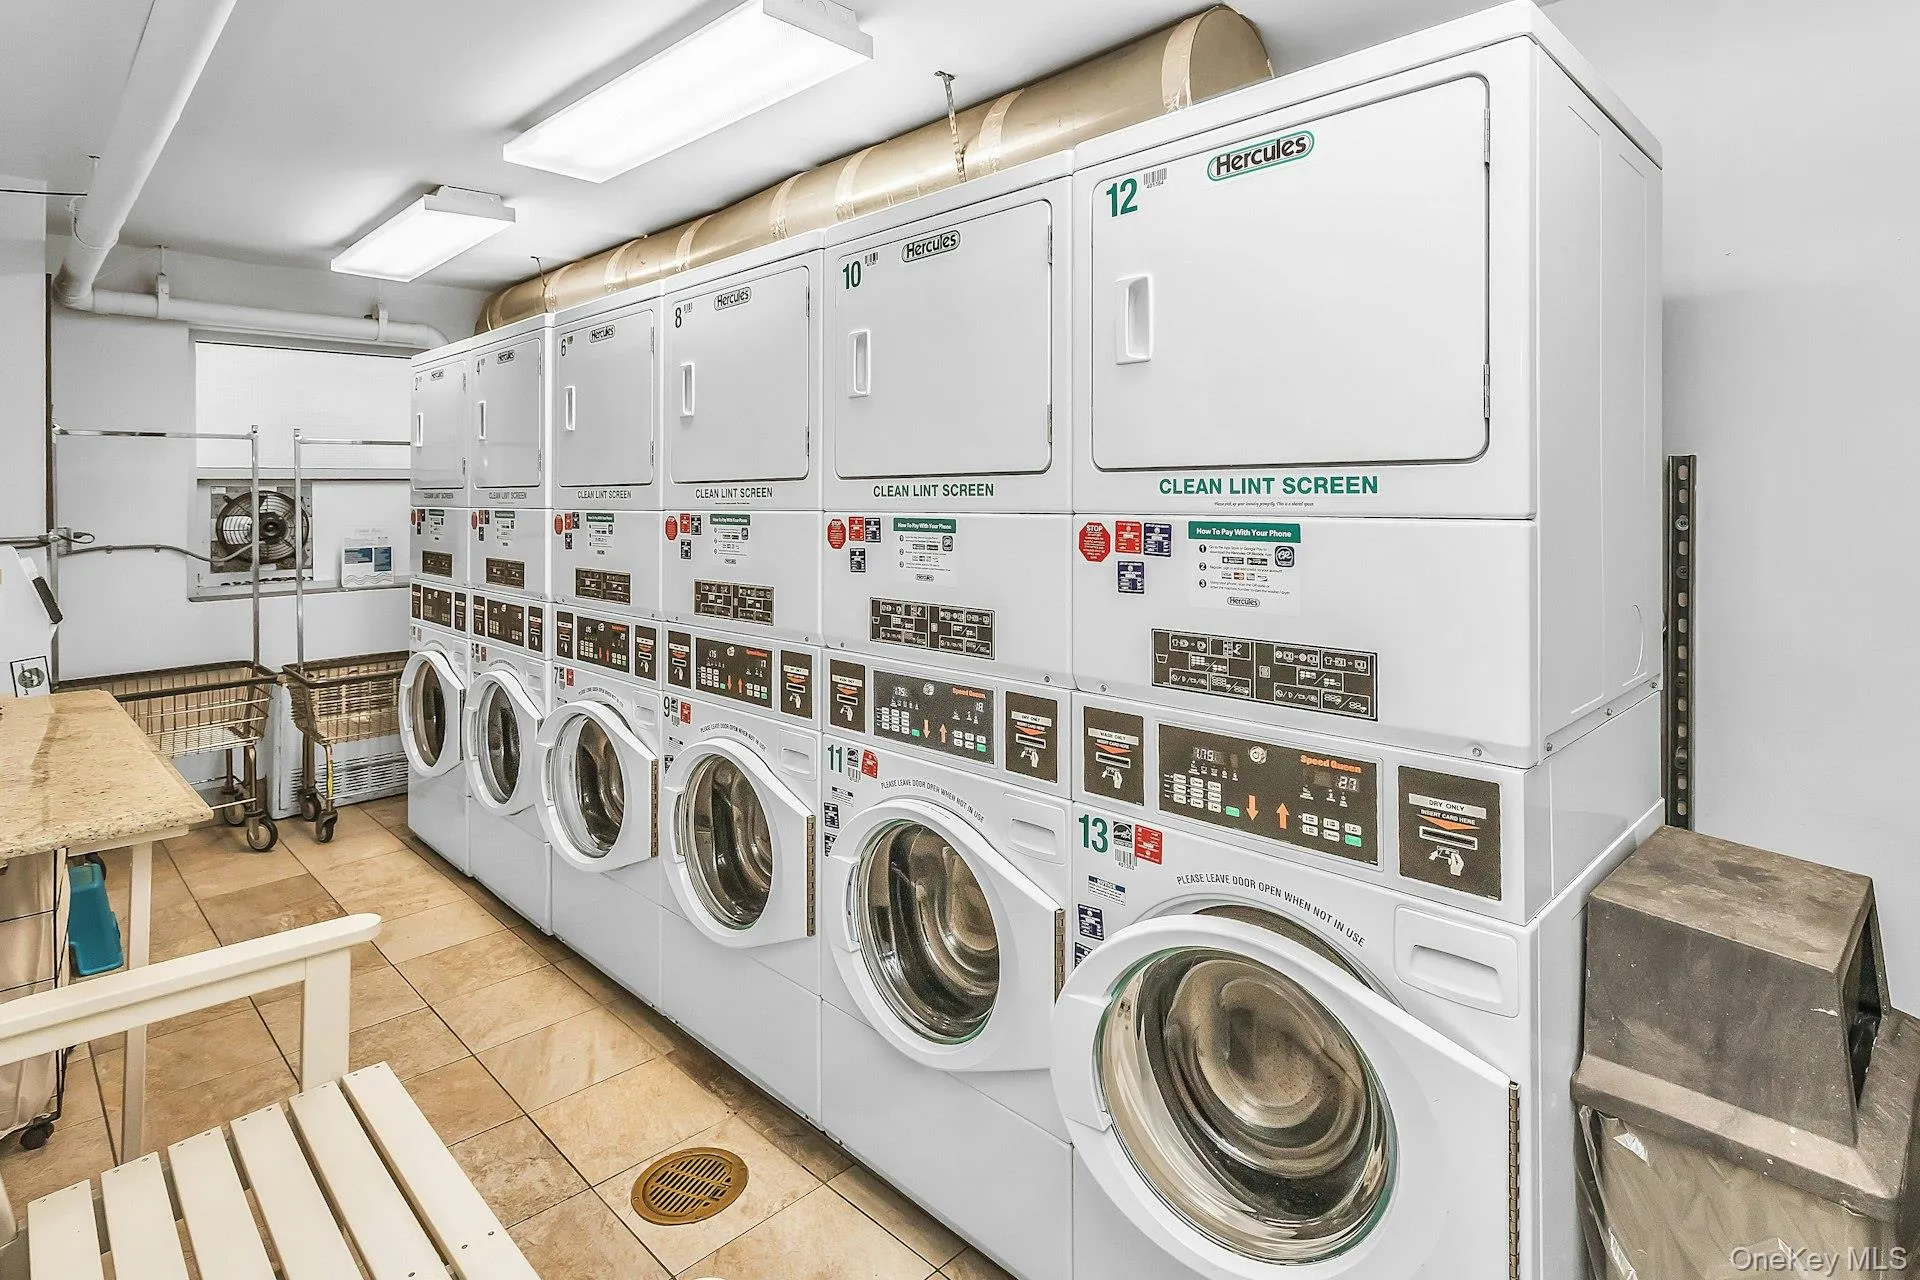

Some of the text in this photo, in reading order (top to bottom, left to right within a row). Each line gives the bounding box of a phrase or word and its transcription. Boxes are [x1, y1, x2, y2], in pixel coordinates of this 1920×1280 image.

[1216, 136, 1307, 176] Hercules
[1106, 178, 1138, 217] 12
[906, 233, 957, 259] Hercules
[842, 261, 861, 290] 10
[717, 290, 749, 308] Hercules
[675, 307, 682, 329] 8
[561, 339, 566, 357] 6
[577, 490, 632, 499] CLEAN LINT SCREEN
[695, 487, 773, 499] CLEAN LINT SCREEN
[873, 483, 994, 498] CLEAN LINT SCREEN
[1159, 475, 1378, 495] CLEAN LINT SCREEN
[1221, 528, 1233, 537] Pay
[1234, 528, 1251, 536] With
[1251, 529, 1268, 537] Your
[1269, 530, 1292, 538] Phone
[1229, 596, 1258, 606] Hercules
[554, 666, 559, 684] 7
[663, 696, 670, 718] 9
[827, 744, 843, 773] 11
[1300, 754, 1362, 774] Speed Queen
[880, 779, 985, 823] PLEASE LEAVE DOOR OPEN WHEN NOT IN USE
[1429, 799, 1465, 812] DRY ONLY
[1420, 809, 1476, 825] INSERT CARD HERE
[1078, 814, 1109, 853] 13
[1176, 873, 1366, 948] PLEASE LEAVE DOOR OPEN WHEN NOT IN USE
